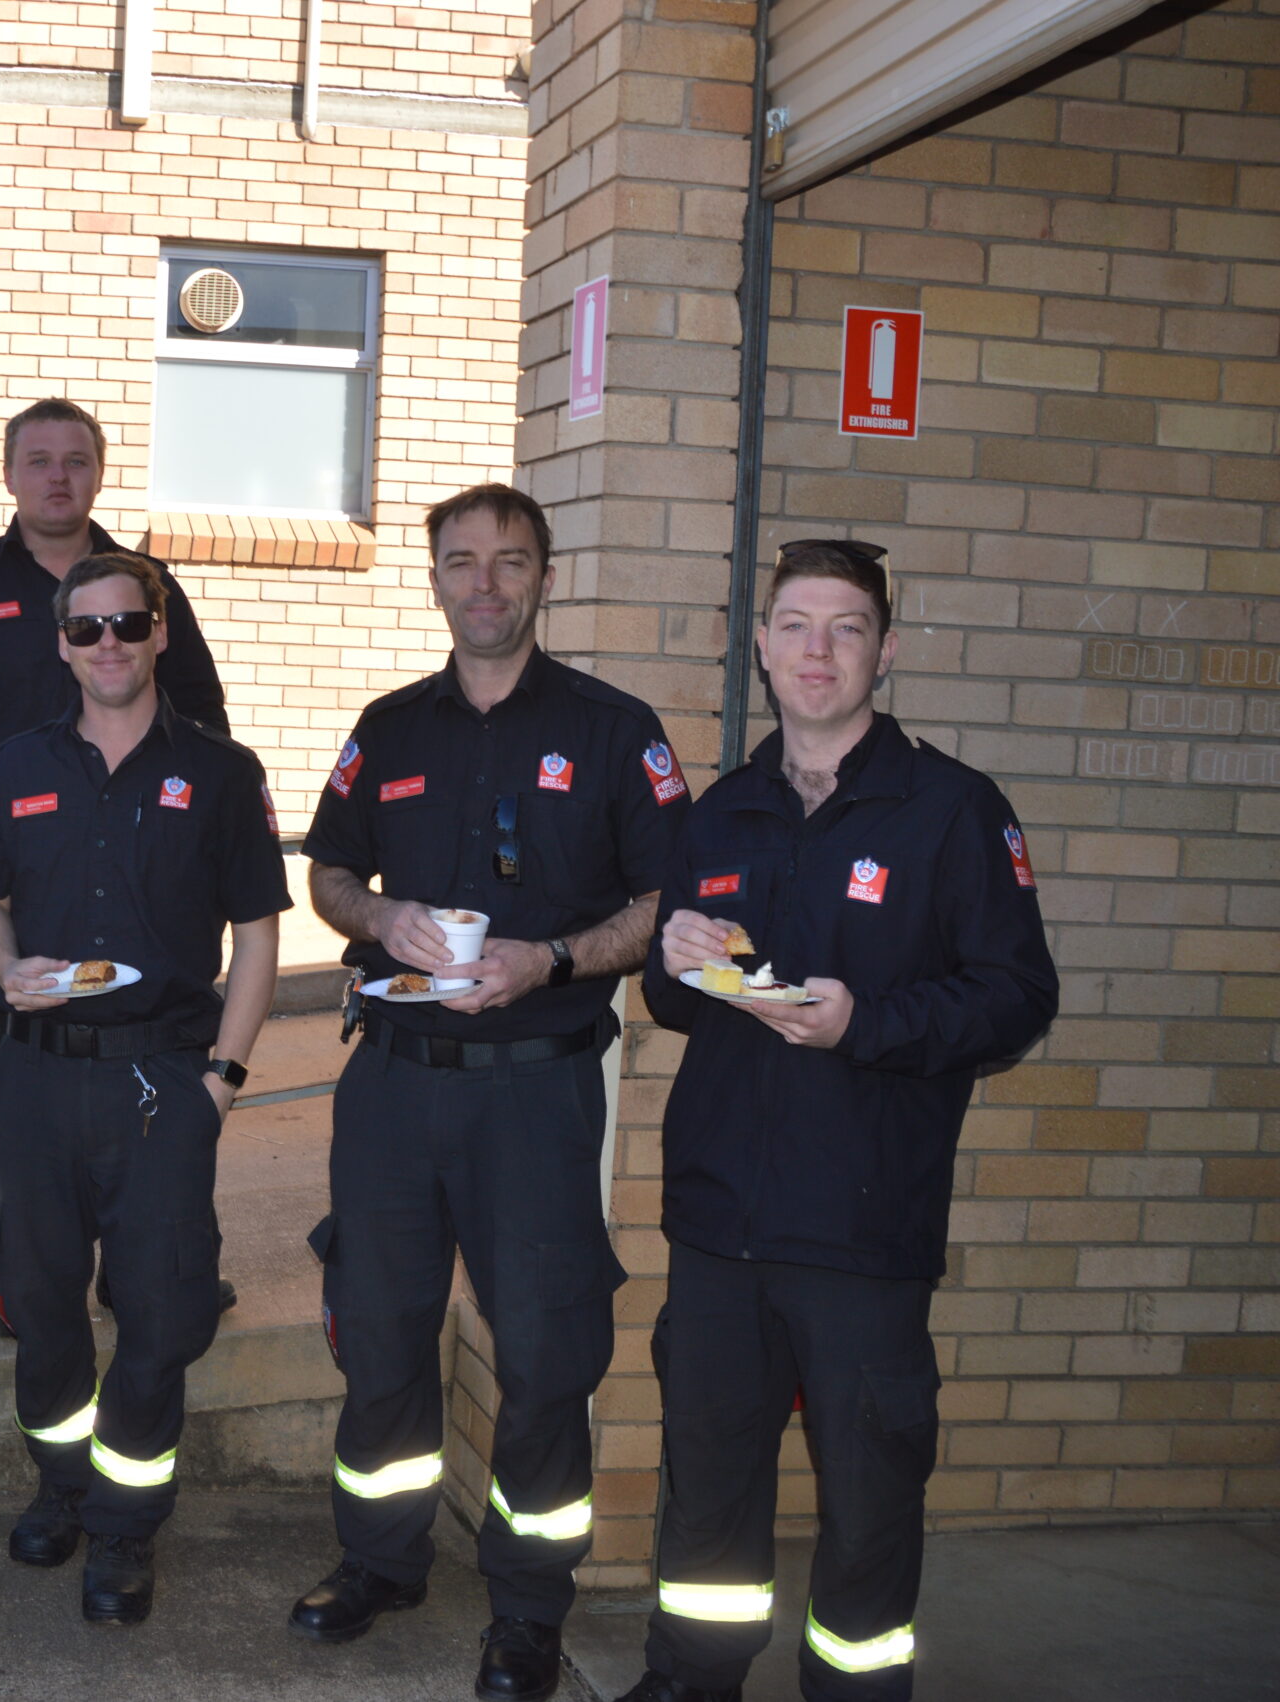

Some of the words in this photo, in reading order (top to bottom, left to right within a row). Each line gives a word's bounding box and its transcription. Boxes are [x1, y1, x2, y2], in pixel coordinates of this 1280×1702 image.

[871, 404, 891, 416] FIRE
[849, 415, 908, 430] EXTINGUISHER
[539, 781, 569, 790] RESCUE
[655, 777, 675, 793] FIRE
[658, 781, 686, 801] RESCUE
[849, 883, 868, 892] FIRE
[848, 889, 881, 902] RESCUE
